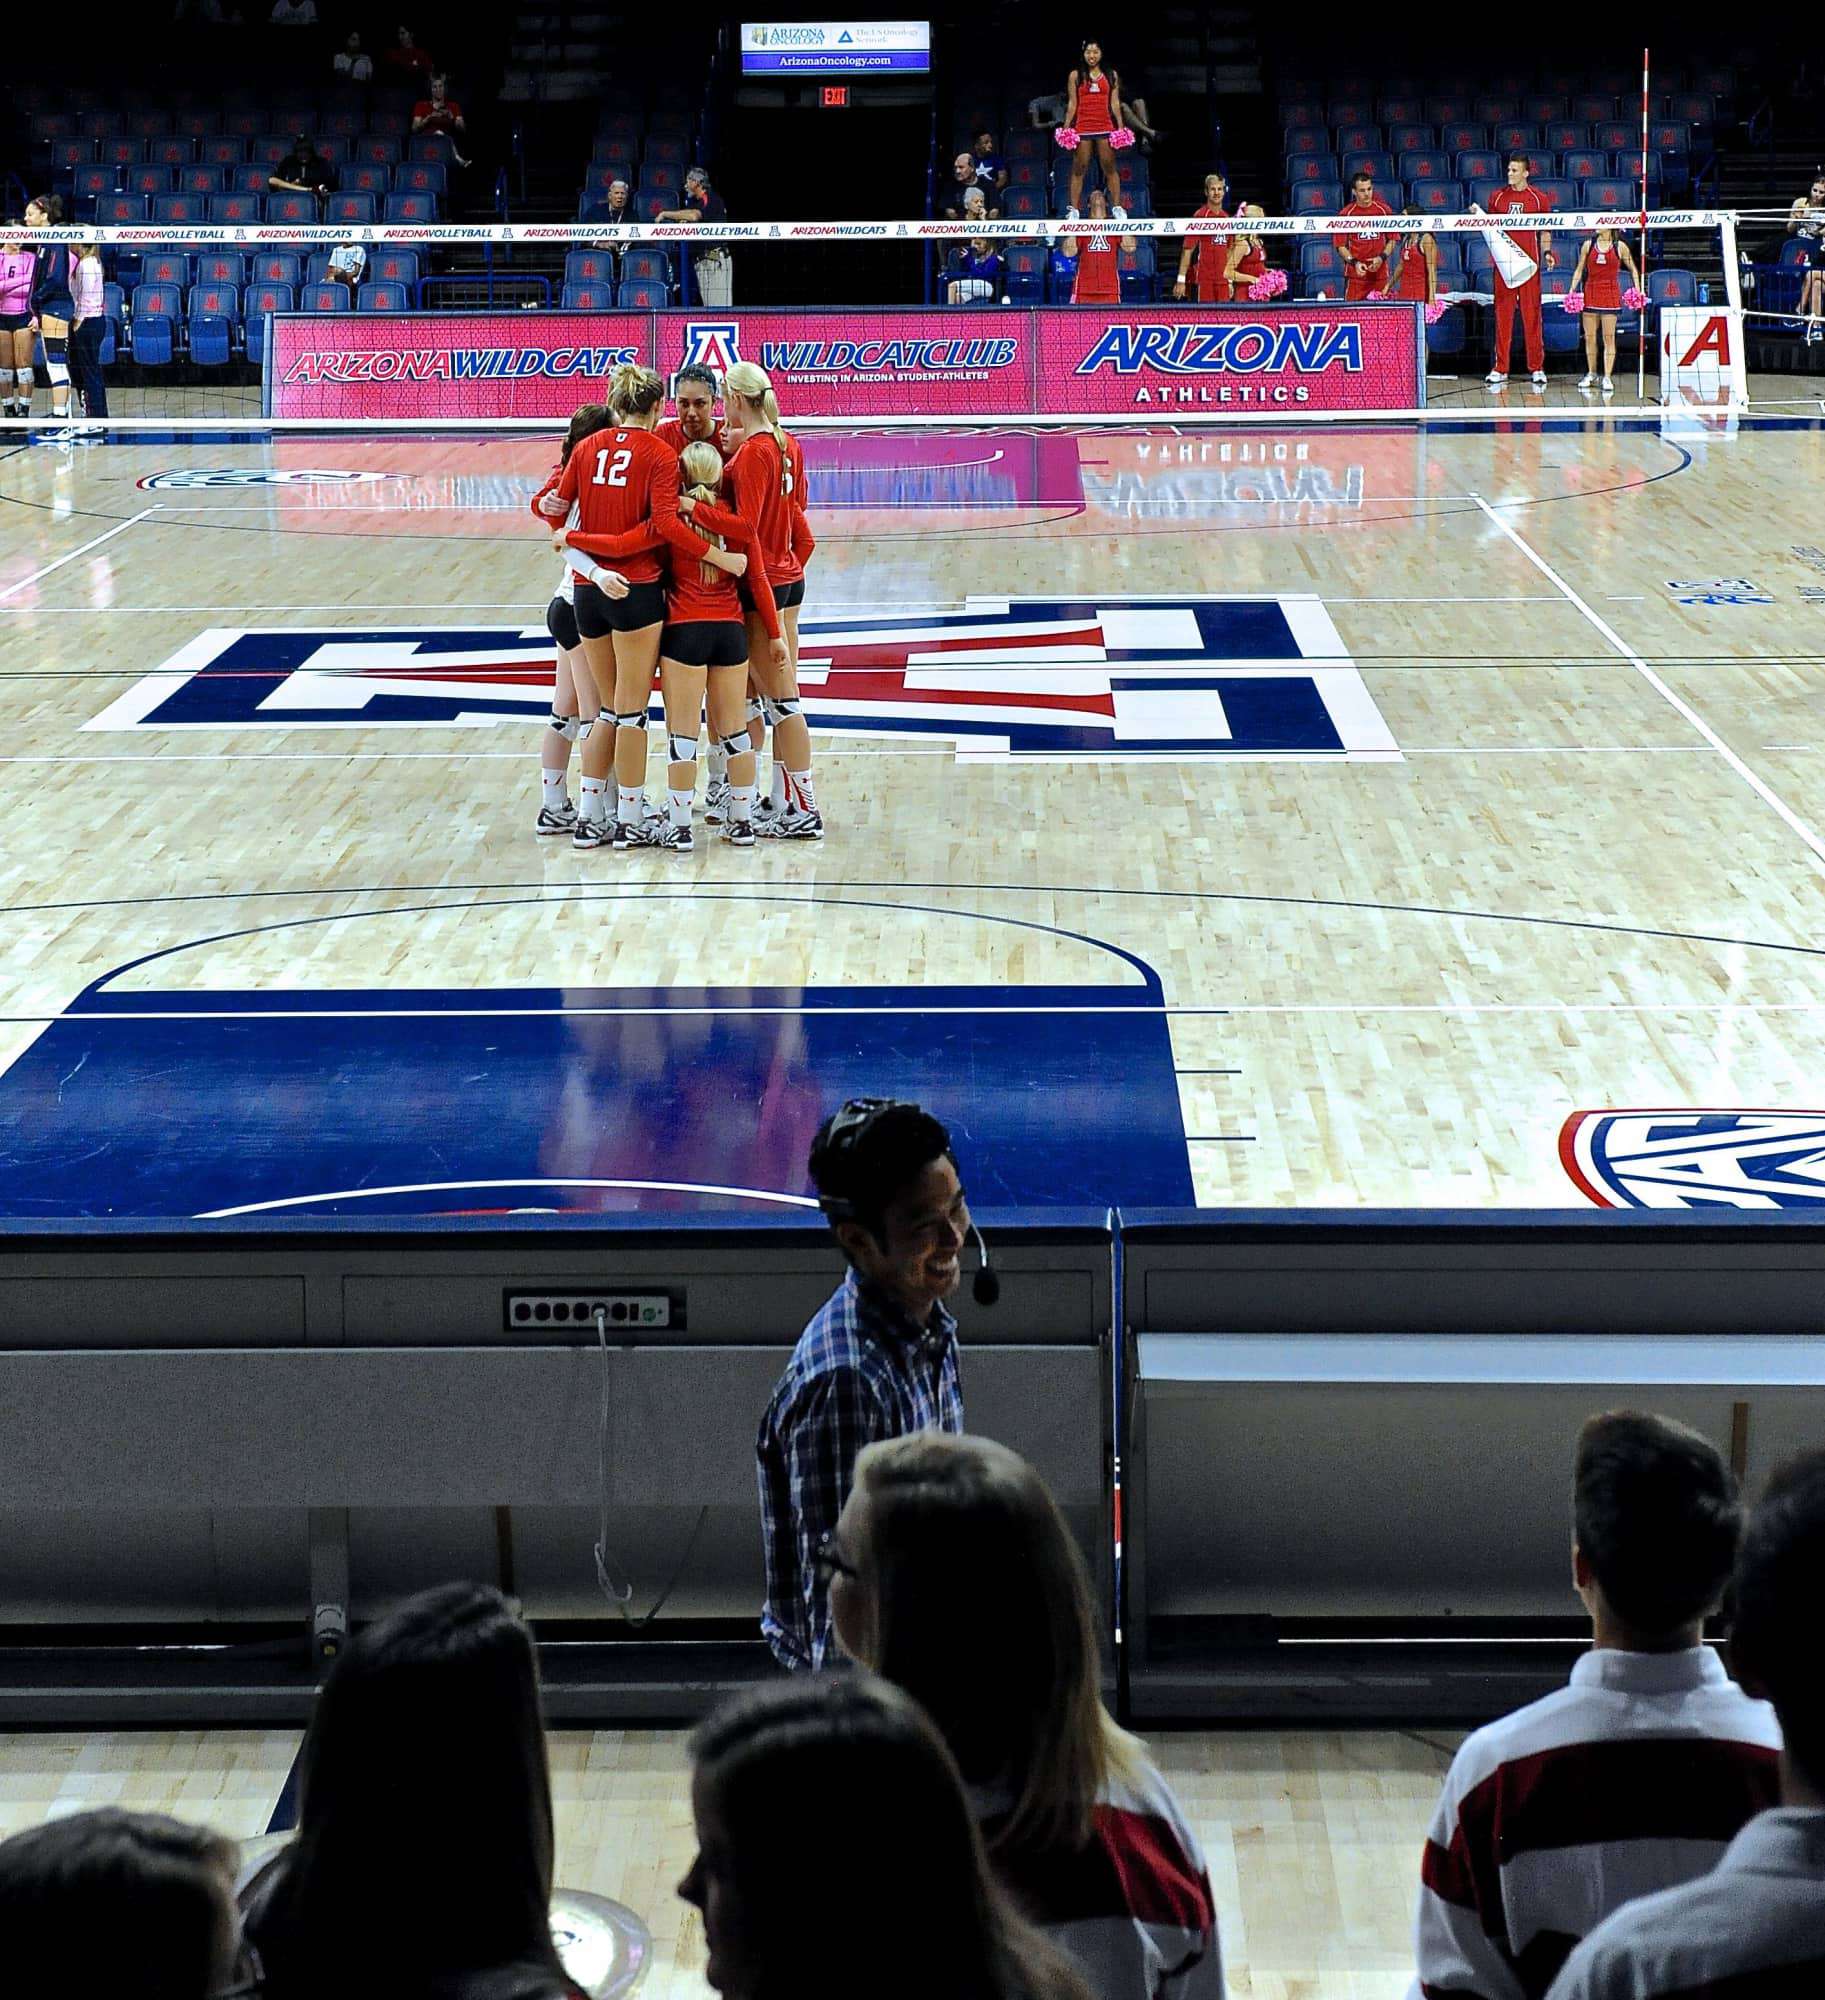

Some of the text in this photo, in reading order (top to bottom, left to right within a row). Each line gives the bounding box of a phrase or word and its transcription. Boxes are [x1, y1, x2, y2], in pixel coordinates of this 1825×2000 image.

[771, 28, 825, 41] ARIZONA
[769, 37, 824, 46] ONCOLOGY
[779, 56, 891, 67] ArizonaOncology.com
[824, 87, 847, 105] EXIT
[0, 231, 84, 240] IZONAWILDCATS
[8, 265, 16, 278] 6
[1075, 323, 1364, 374] ARIZONA
[668, 321, 740, 399] A
[787, 371, 990, 384] INVESTING IN ARIZONA STUDENT-ATHLETES
[1136, 387, 1310, 401] ATHLETICS
[592, 448, 632, 487] 12
